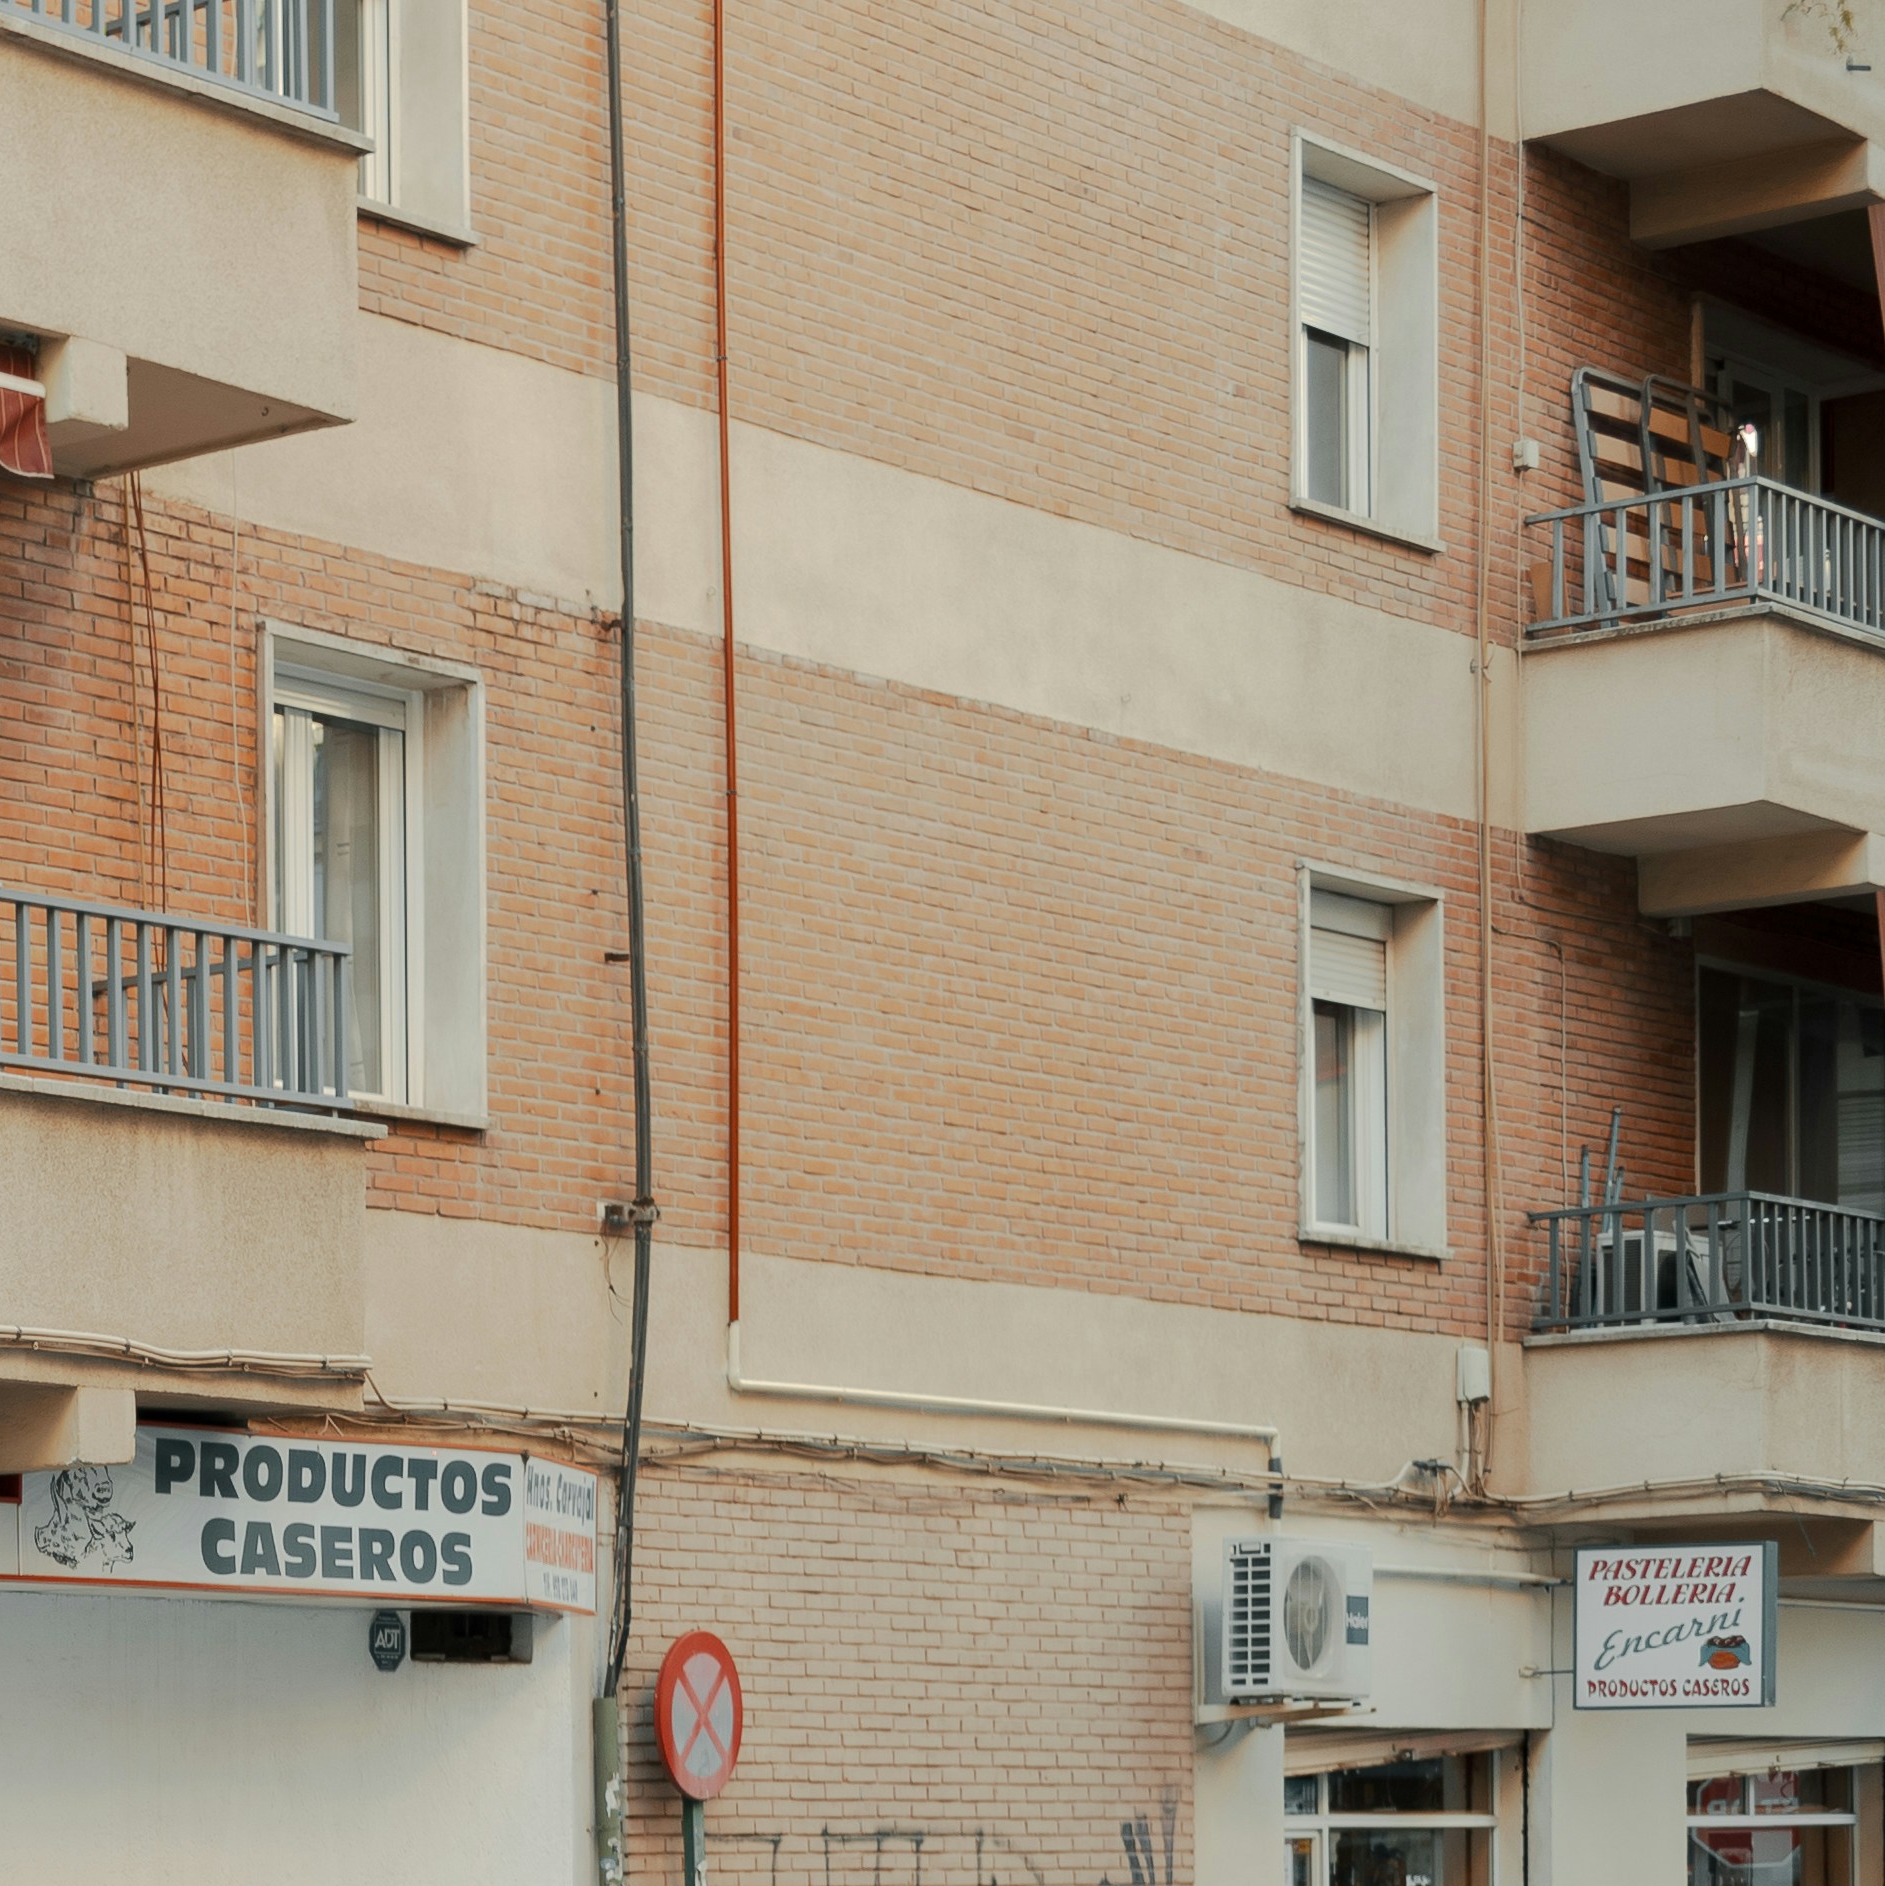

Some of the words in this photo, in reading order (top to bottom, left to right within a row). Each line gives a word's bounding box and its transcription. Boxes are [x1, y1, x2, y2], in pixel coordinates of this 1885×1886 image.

[154, 1437, 513, 1518] PRODUCTOS
[526, 1465, 553, 1513] Hnos.
[556, 1472, 595, 1527] Carvajal
[200, 1517, 474, 1586] CASEROS
[1588, 1555, 1752, 1581] PASTELERIA
[374, 1628, 400, 1649] ADT
[1593, 1608, 1742, 1671] Encarni
[1587, 1678, 1677, 1698] PRODUCTOS
[1682, 1678, 1750, 1697] CASEROS
